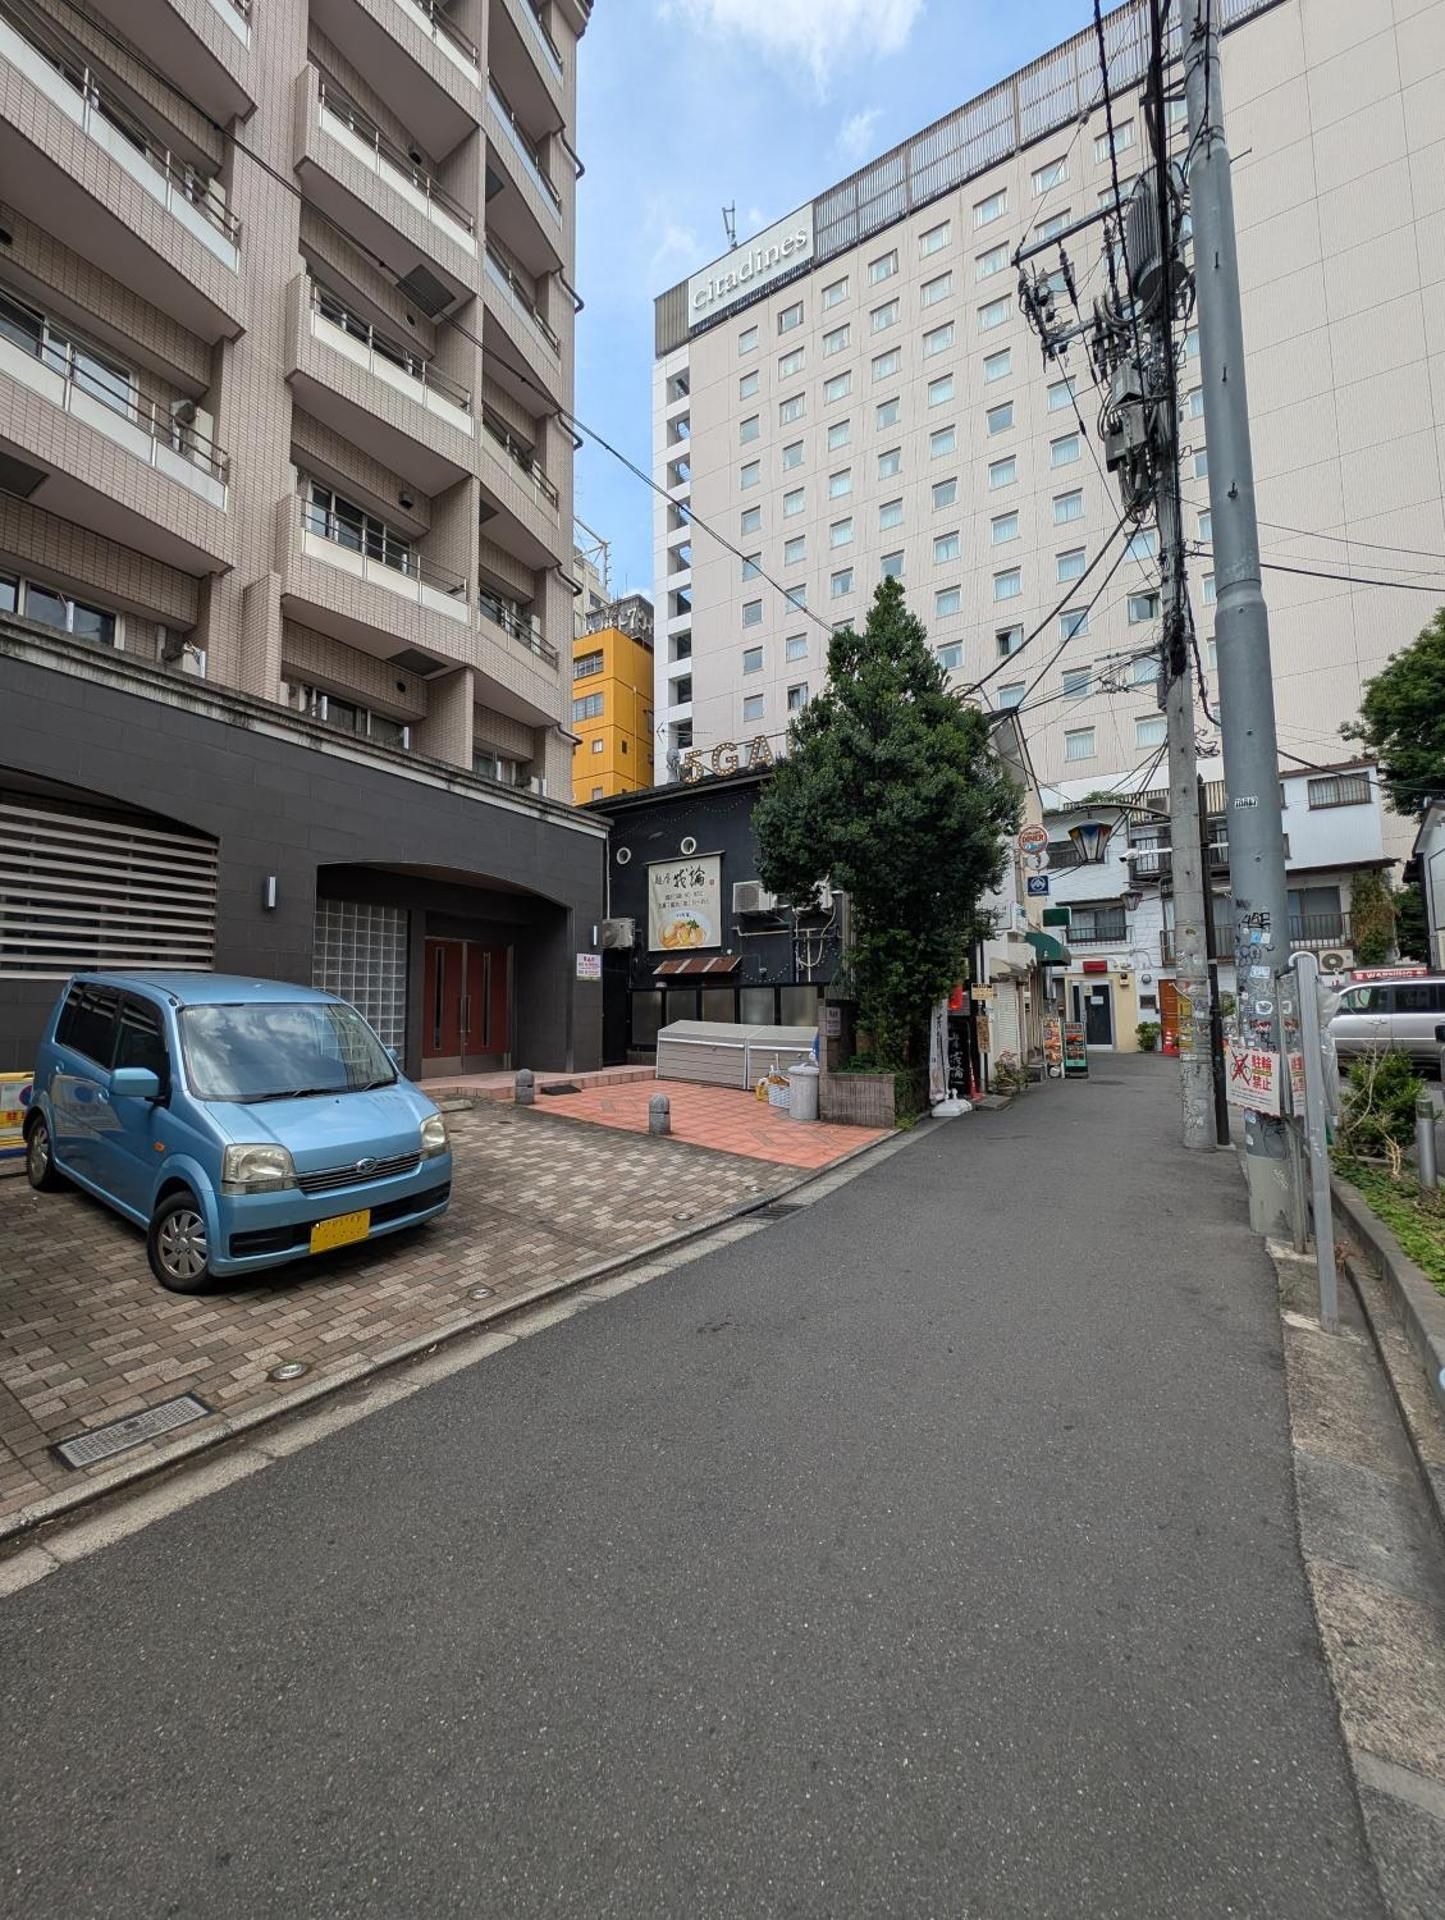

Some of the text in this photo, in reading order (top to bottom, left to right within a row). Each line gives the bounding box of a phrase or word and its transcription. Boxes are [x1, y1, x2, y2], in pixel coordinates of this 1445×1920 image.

[693, 228, 808, 310] citadines
[1251, 1054, 1272, 1071] 駐輪
[1252, 1075, 1272, 1092] 禁止
